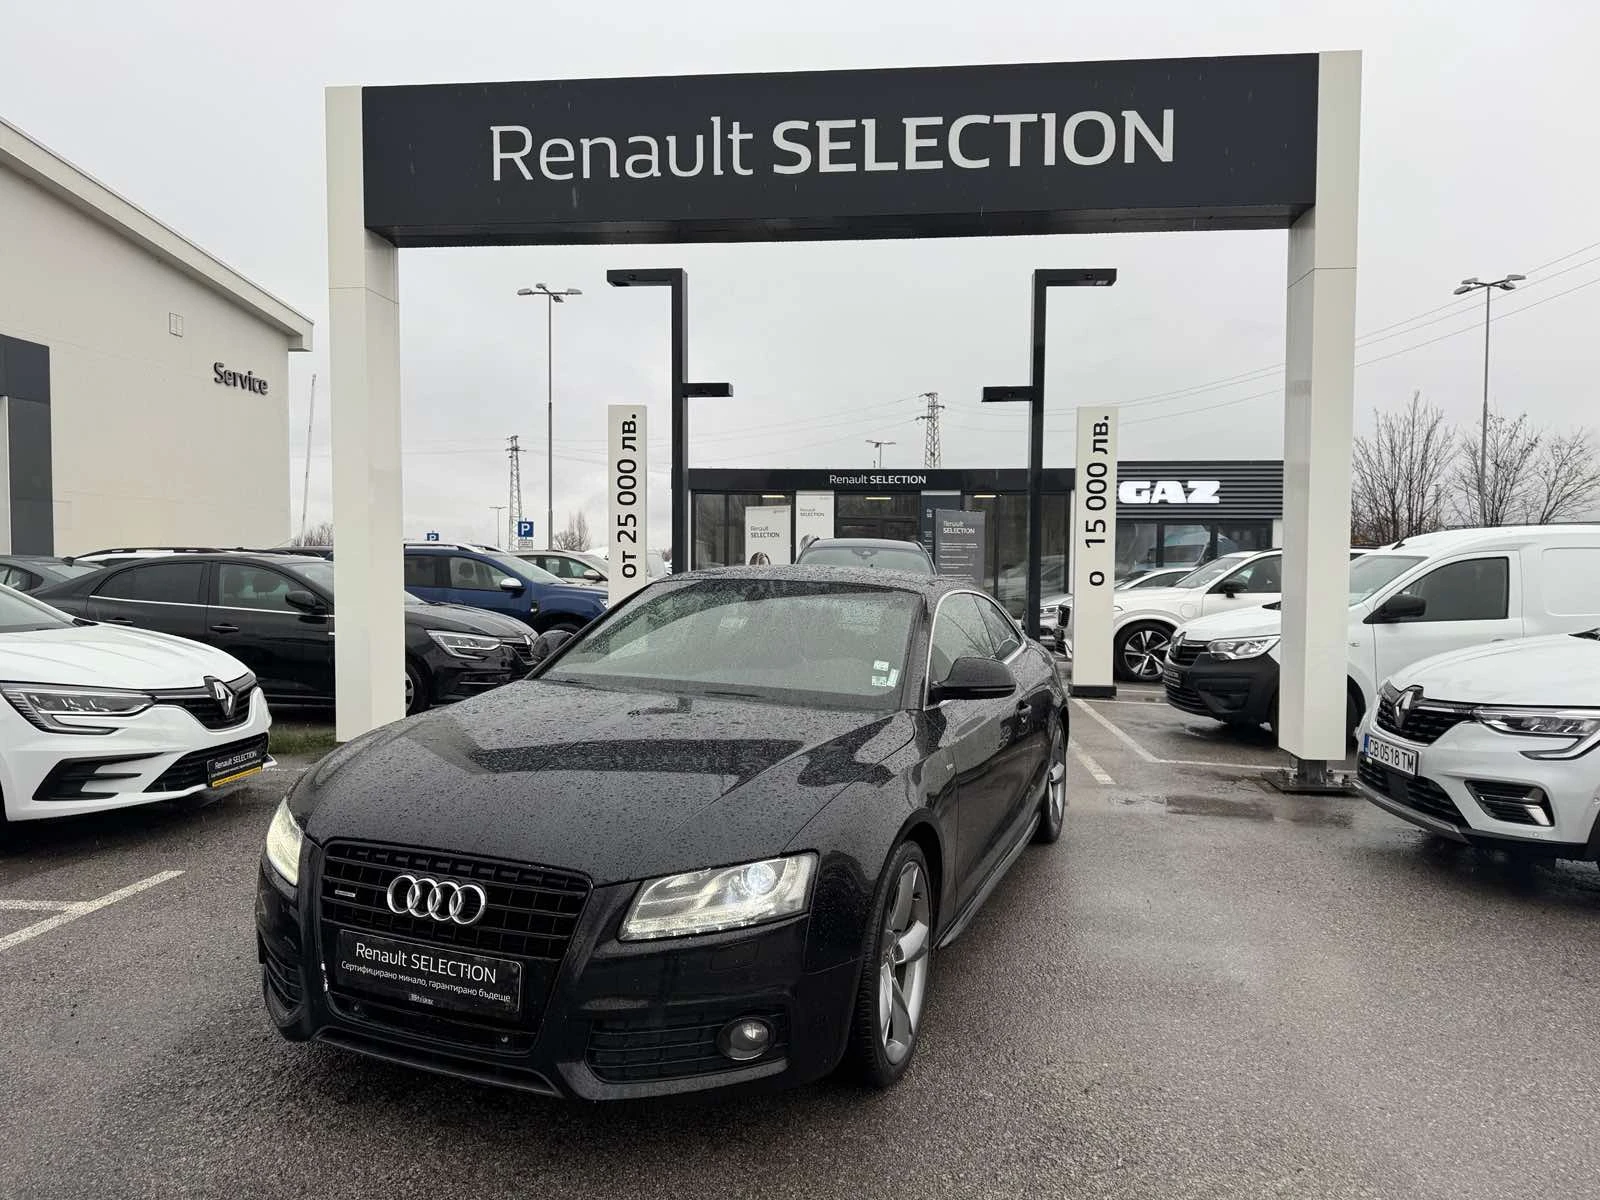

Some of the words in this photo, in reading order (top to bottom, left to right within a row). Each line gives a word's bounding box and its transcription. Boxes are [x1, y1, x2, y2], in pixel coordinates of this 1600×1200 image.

[490, 116, 753, 181] Renault
[772, 109, 1175, 175] SELECTION
[213, 361, 268, 395] Service
[622, 414, 637, 452] лв.
[1093, 415, 1109, 455] лв.
[617, 459, 637, 506] 000
[829, 474, 867, 484] Renault
[869, 475, 927, 484] SELECTION
[1086, 462, 1108, 511] 000
[1118, 480, 1220, 504] GAZ
[521, 523, 530, 535] P
[617, 514, 637, 543] 25
[1085, 519, 1106, 548] 15
[622, 551, 637, 578] от
[214, 758, 233, 769] Renault
[233, 751, 257, 764] SELECTION
[1370, 739, 1379, 757] CB
[1380, 743, 1400, 766] 0518
[1402, 751, 1414, 772] TM
[355, 942, 408, 967] Renault
[411, 953, 496, 984] SELECTION
[341, 960, 397, 979] Сертифицирано
[399, 974, 427, 987] минало,
[428, 980, 478, 997] гарантирано
[478, 988, 511, 1002] бъдеще
